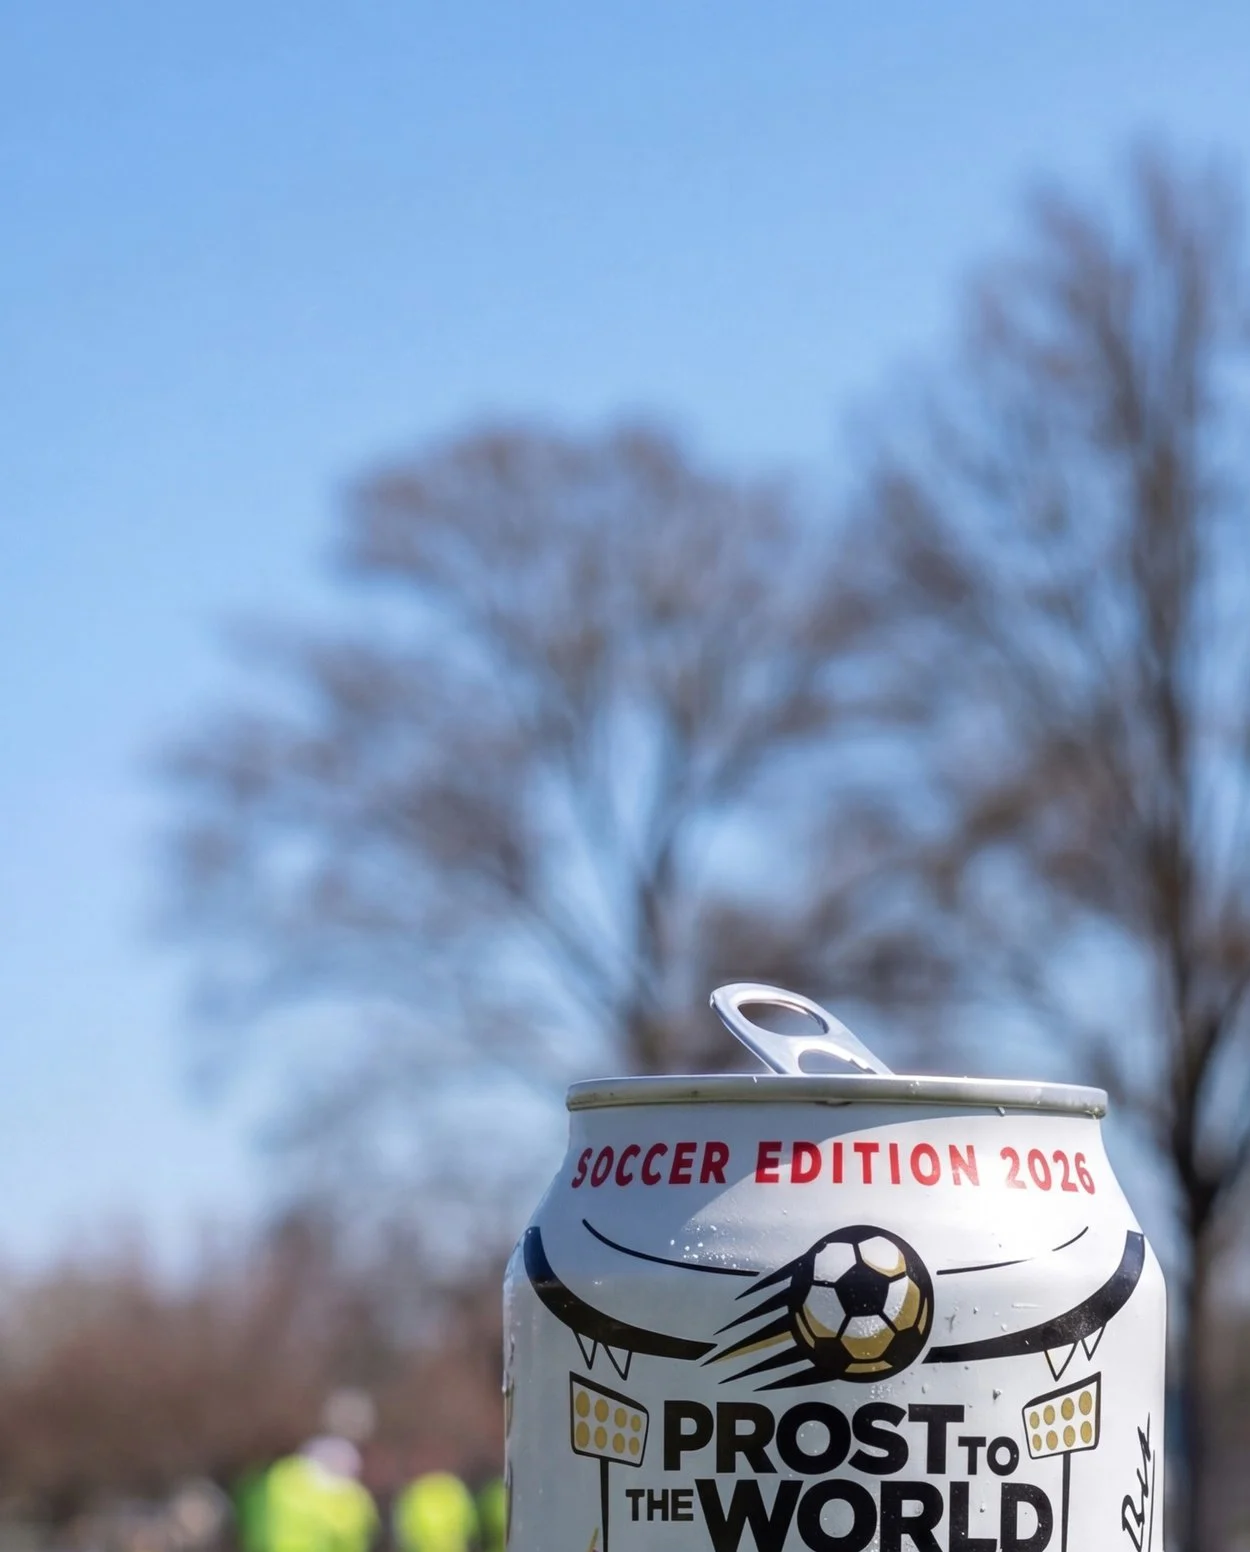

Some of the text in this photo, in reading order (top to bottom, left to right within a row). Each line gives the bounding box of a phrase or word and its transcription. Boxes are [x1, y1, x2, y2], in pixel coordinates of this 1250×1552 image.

[571, 1142, 1096, 1195] SOCCER EDITION 2026
[663, 1401, 1020, 1477] PROST TO
[625, 1488, 694, 1521] THE
